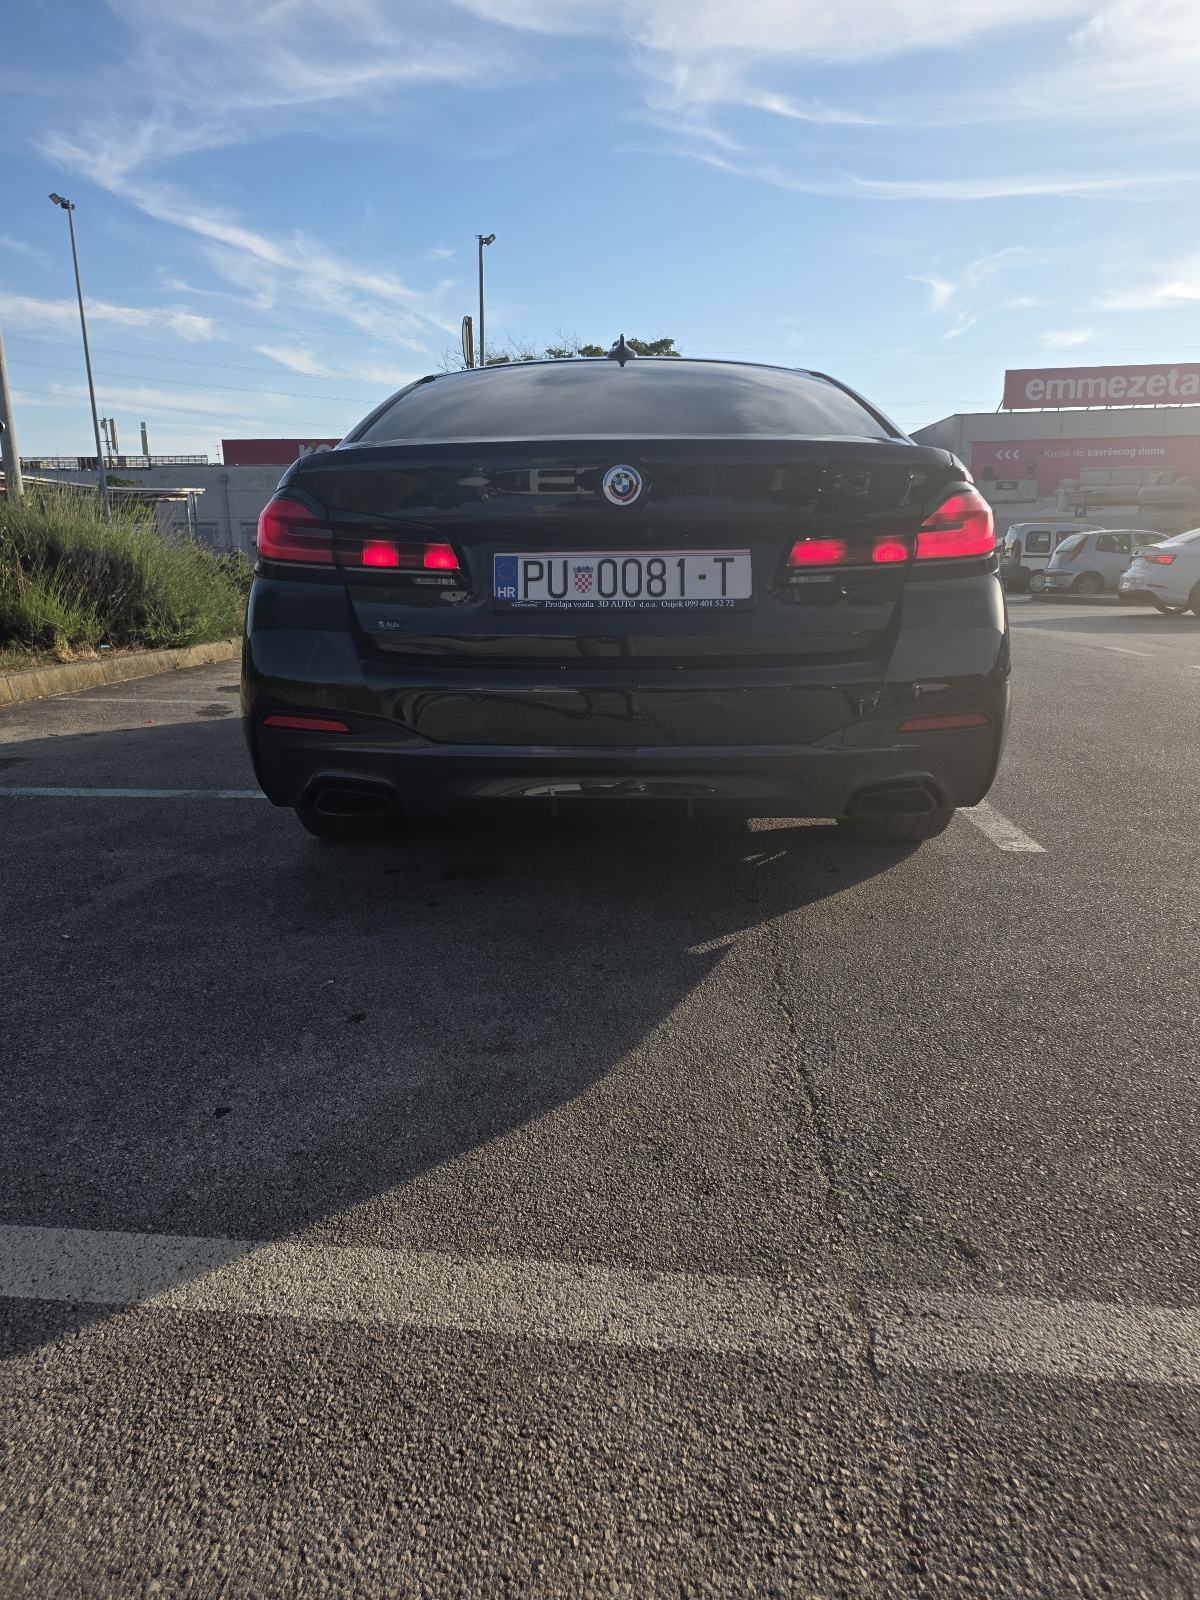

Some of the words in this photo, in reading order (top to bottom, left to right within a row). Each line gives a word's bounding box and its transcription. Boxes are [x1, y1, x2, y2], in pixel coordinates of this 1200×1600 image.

[1025, 368, 1200, 400] emmezeta
[1073, 449, 1085, 457] do
[1087, 447, 1135, 457] savršenog
[1138, 446, 1165, 455] doma
[523, 560, 568, 599] PU
[498, 586, 515, 597] HR
[545, 600, 572, 609] Prodaja
[573, 600, 594, 608] vozila
[597, 600, 609, 608] 3D
[610, 600, 636, 608] AUTO
[639, 600, 658, 608] d.o.o.
[661, 600, 682, 609] Osijek
